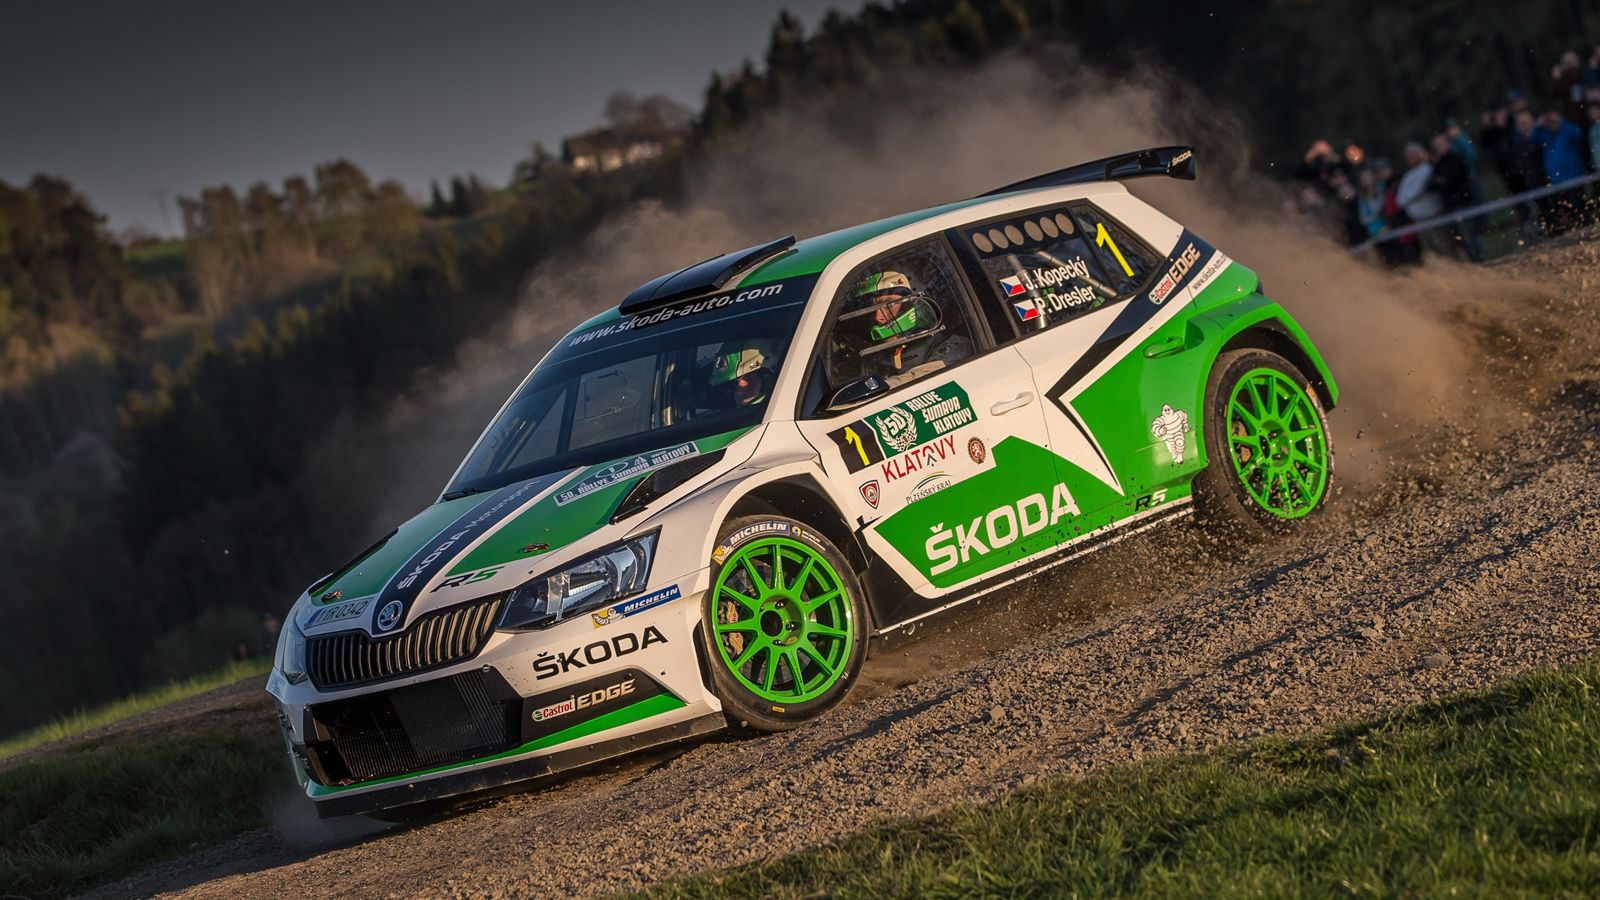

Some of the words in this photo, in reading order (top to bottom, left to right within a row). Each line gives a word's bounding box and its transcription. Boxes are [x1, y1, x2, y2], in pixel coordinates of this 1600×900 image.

[1095, 222, 1136, 278] 1
[1023, 272, 1038, 291] J.
[1033, 255, 1091, 288] Kopecký
[1153, 275, 1174, 301] Castrol
[1168, 242, 1201, 285] EDGE
[569, 283, 784, 348] www.skoda-auto.com
[1034, 297, 1053, 316] P.
[1047, 285, 1097, 312] Dresler
[905, 390, 943, 412] RALLYE
[883, 411, 907, 436] 50
[932, 407, 974, 435] KLATOVY
[844, 425, 871, 467] 1
[881, 434, 957, 484] KLATOVY
[578, 477, 610, 495] RALLYE
[1135, 488, 1169, 513] R5
[730, 522, 788, 544] MICHELIN
[924, 481, 1082, 577] ŠKODA
[396, 528, 470, 590] ŠKODA
[429, 565, 506, 594] R5
[624, 586, 679, 613] MICHELIN
[532, 625, 669, 681] ŠKODA
[542, 702, 574, 719] Castrol
[576, 679, 637, 711] EDGE
